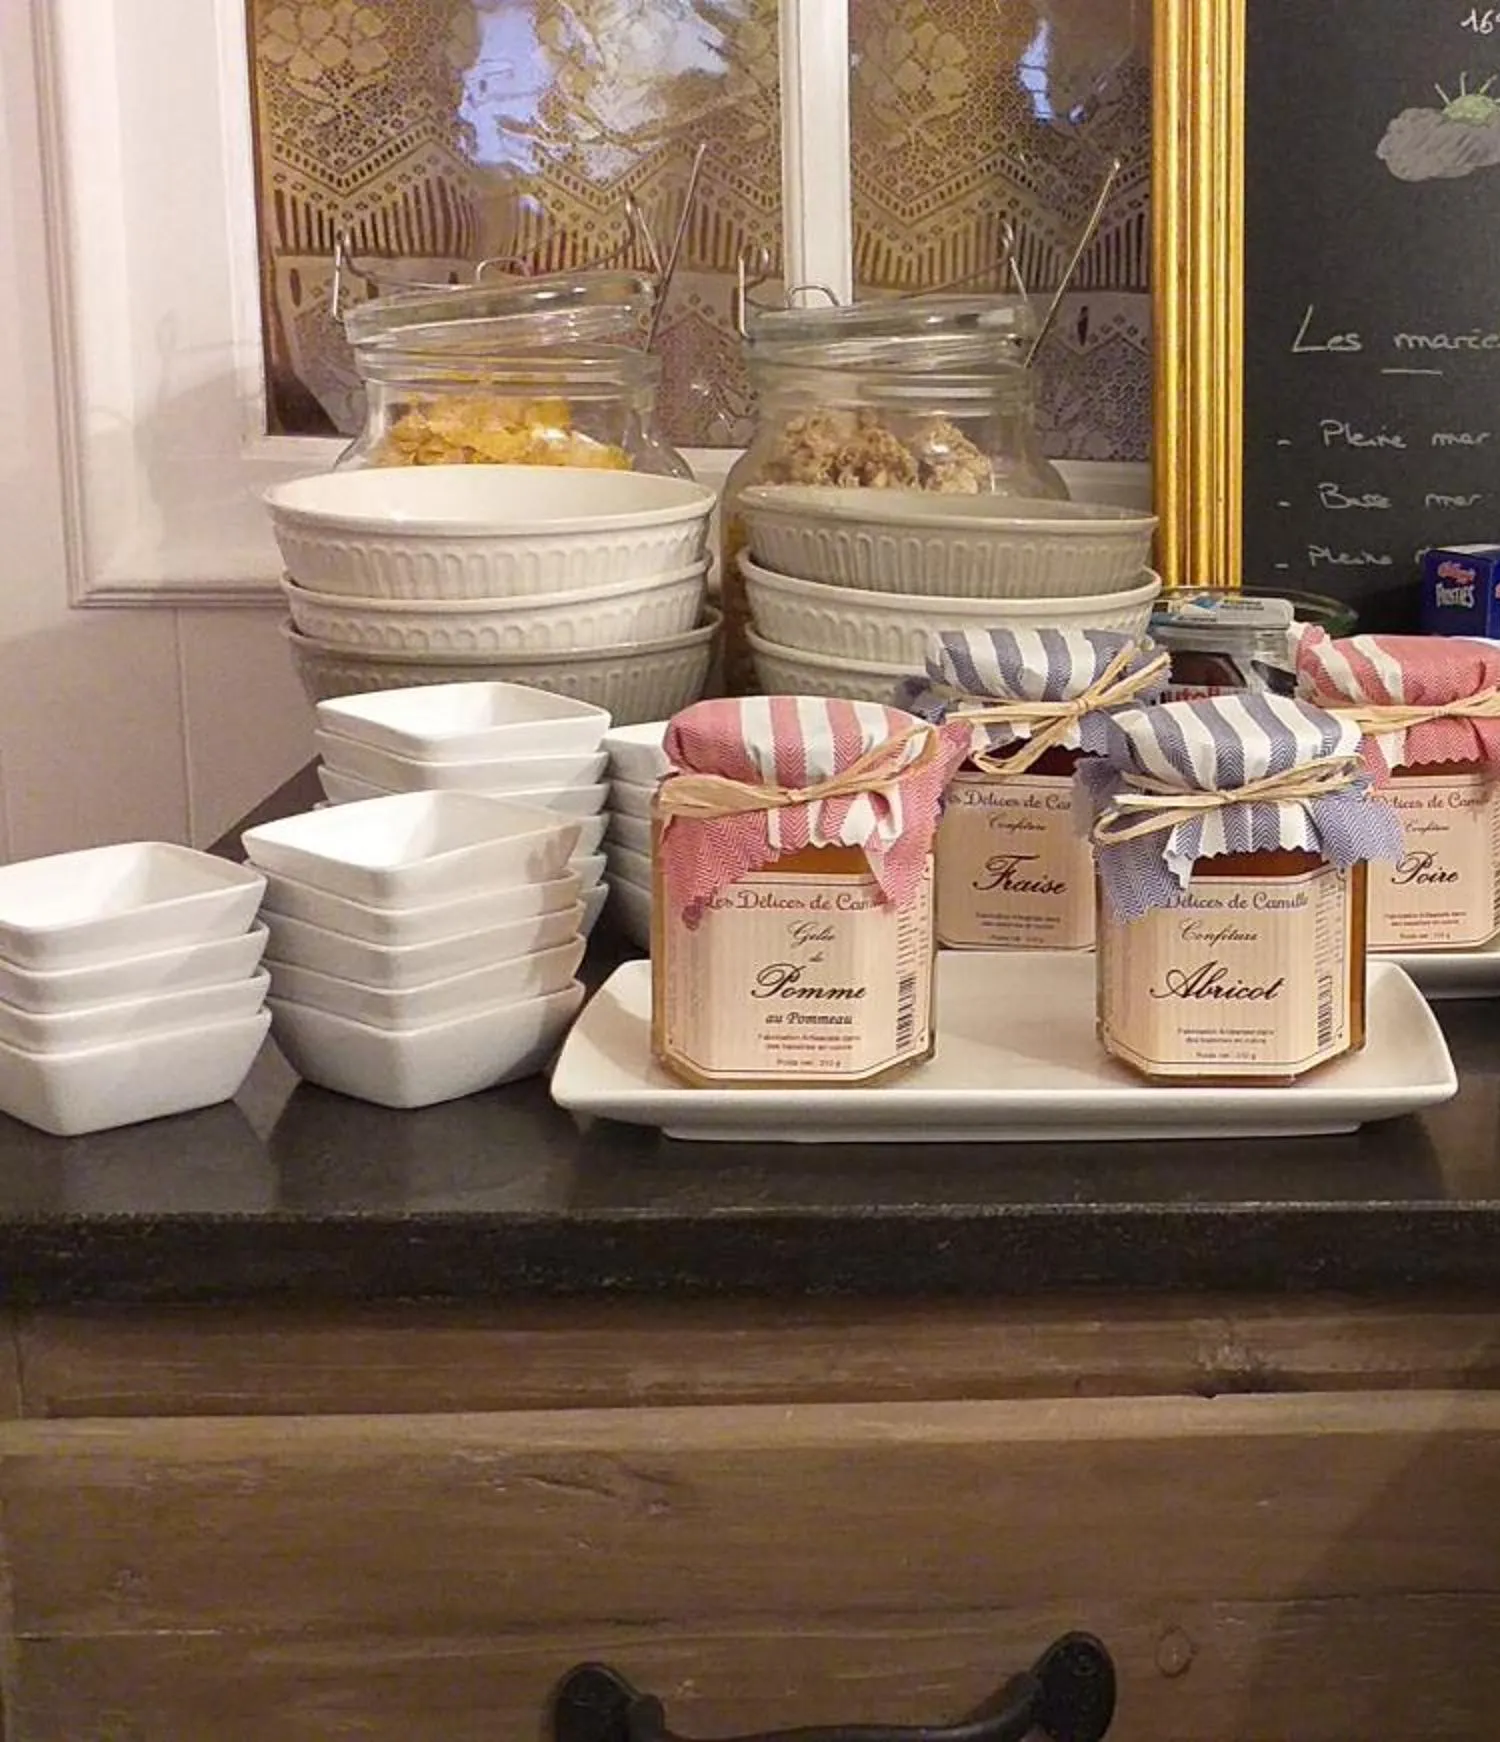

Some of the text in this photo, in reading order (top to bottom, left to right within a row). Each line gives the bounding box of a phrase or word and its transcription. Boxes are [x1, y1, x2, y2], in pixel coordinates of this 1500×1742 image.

[1292, 303, 1363, 353] Les
[1319, 418, 1408, 449] Pleine
[1307, 544, 1394, 568] Pleine
[972, 853, 1069, 895] Fraise
[1391, 850, 1460, 886] Poire
[809, 892, 832, 910] de
[1227, 892, 1249, 910] de
[751, 963, 867, 1000] Pomme
[1149, 958, 1288, 1001] Abricot
[765, 1011, 853, 1025] au Pommeau
